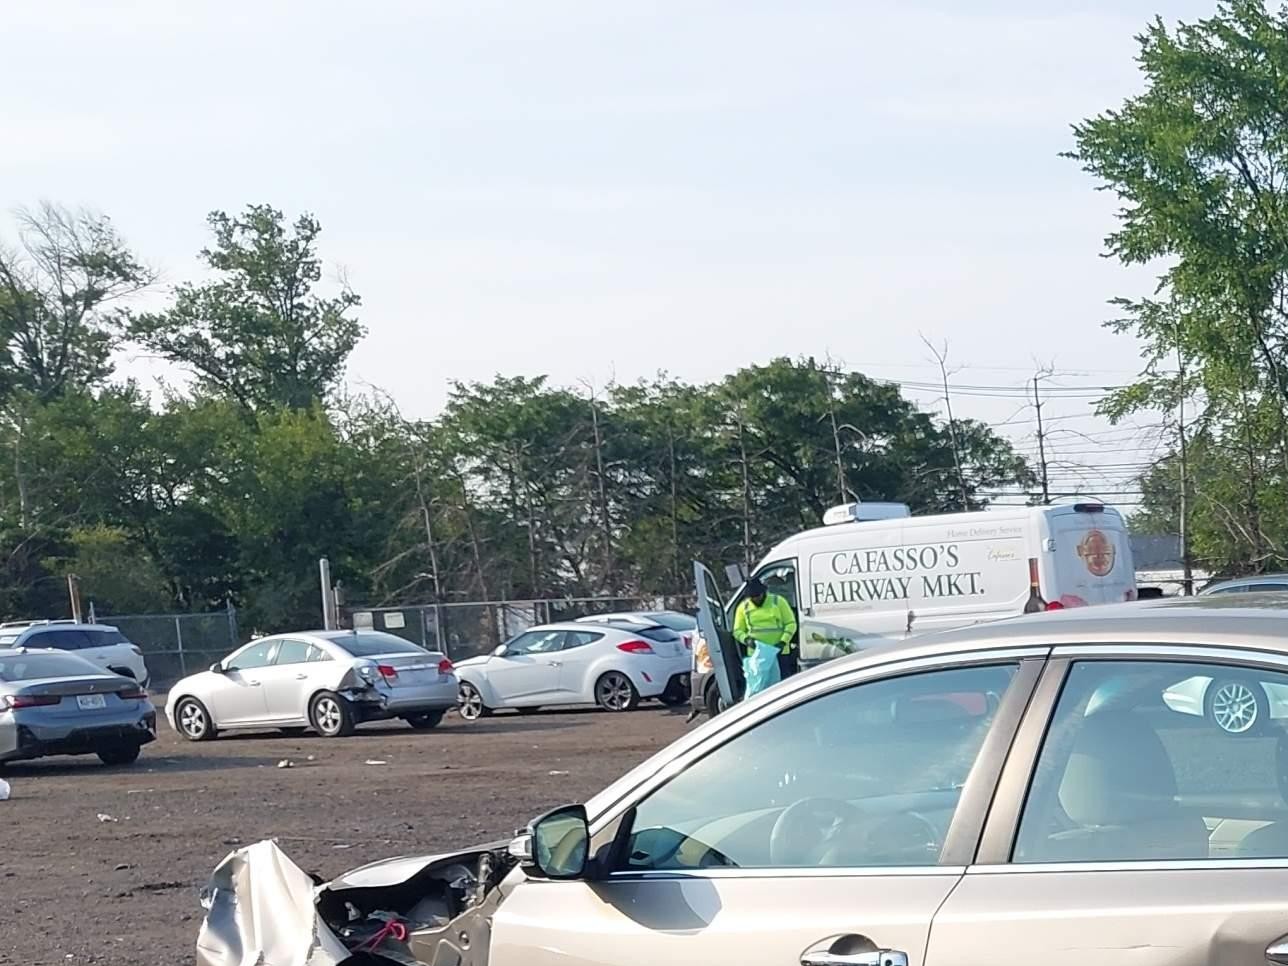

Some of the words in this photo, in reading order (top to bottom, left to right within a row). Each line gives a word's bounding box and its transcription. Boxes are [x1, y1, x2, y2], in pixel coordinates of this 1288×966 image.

[831, 544, 960, 576] CAFASSO'S
[812, 576, 913, 605] FAIRWAY
[921, 572, 986, 598] MKT.
